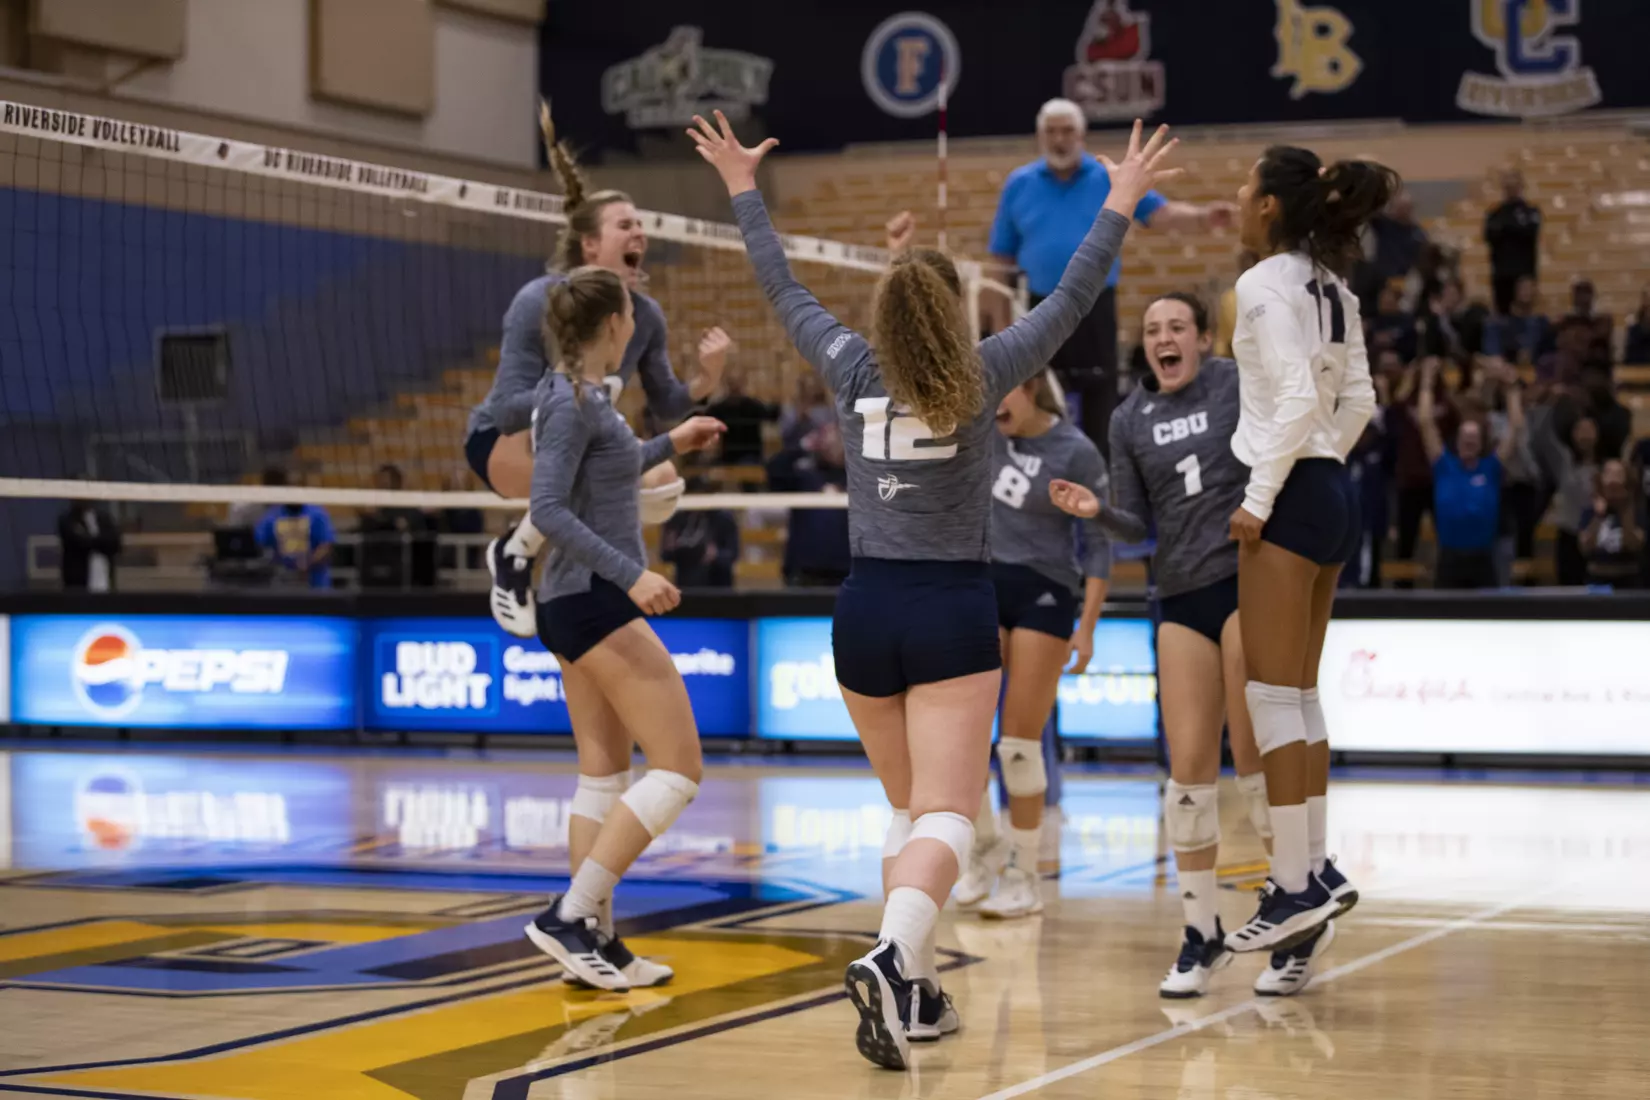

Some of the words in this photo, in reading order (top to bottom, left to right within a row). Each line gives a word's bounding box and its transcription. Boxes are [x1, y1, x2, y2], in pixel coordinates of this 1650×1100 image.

[894, 37, 931, 95] F
[1068, 68, 1158, 105] CSUN
[3, 102, 87, 137] RIVERSIDE
[92, 120, 181, 153] VOLLEYBALL
[264, 149, 281, 168] UC
[286, 152, 353, 183] RIVERSIDE
[358, 166, 428, 193] VOLLEYBALL
[853, 396, 958, 460] 12
[1152, 410, 1209, 446] CBU
[992, 465, 1031, 509] 8
[1175, 453, 1204, 497] 1
[134, 648, 289, 694] PEPSI
[395, 641, 478, 676] BUD
[381, 672, 492, 710] LIGHT
